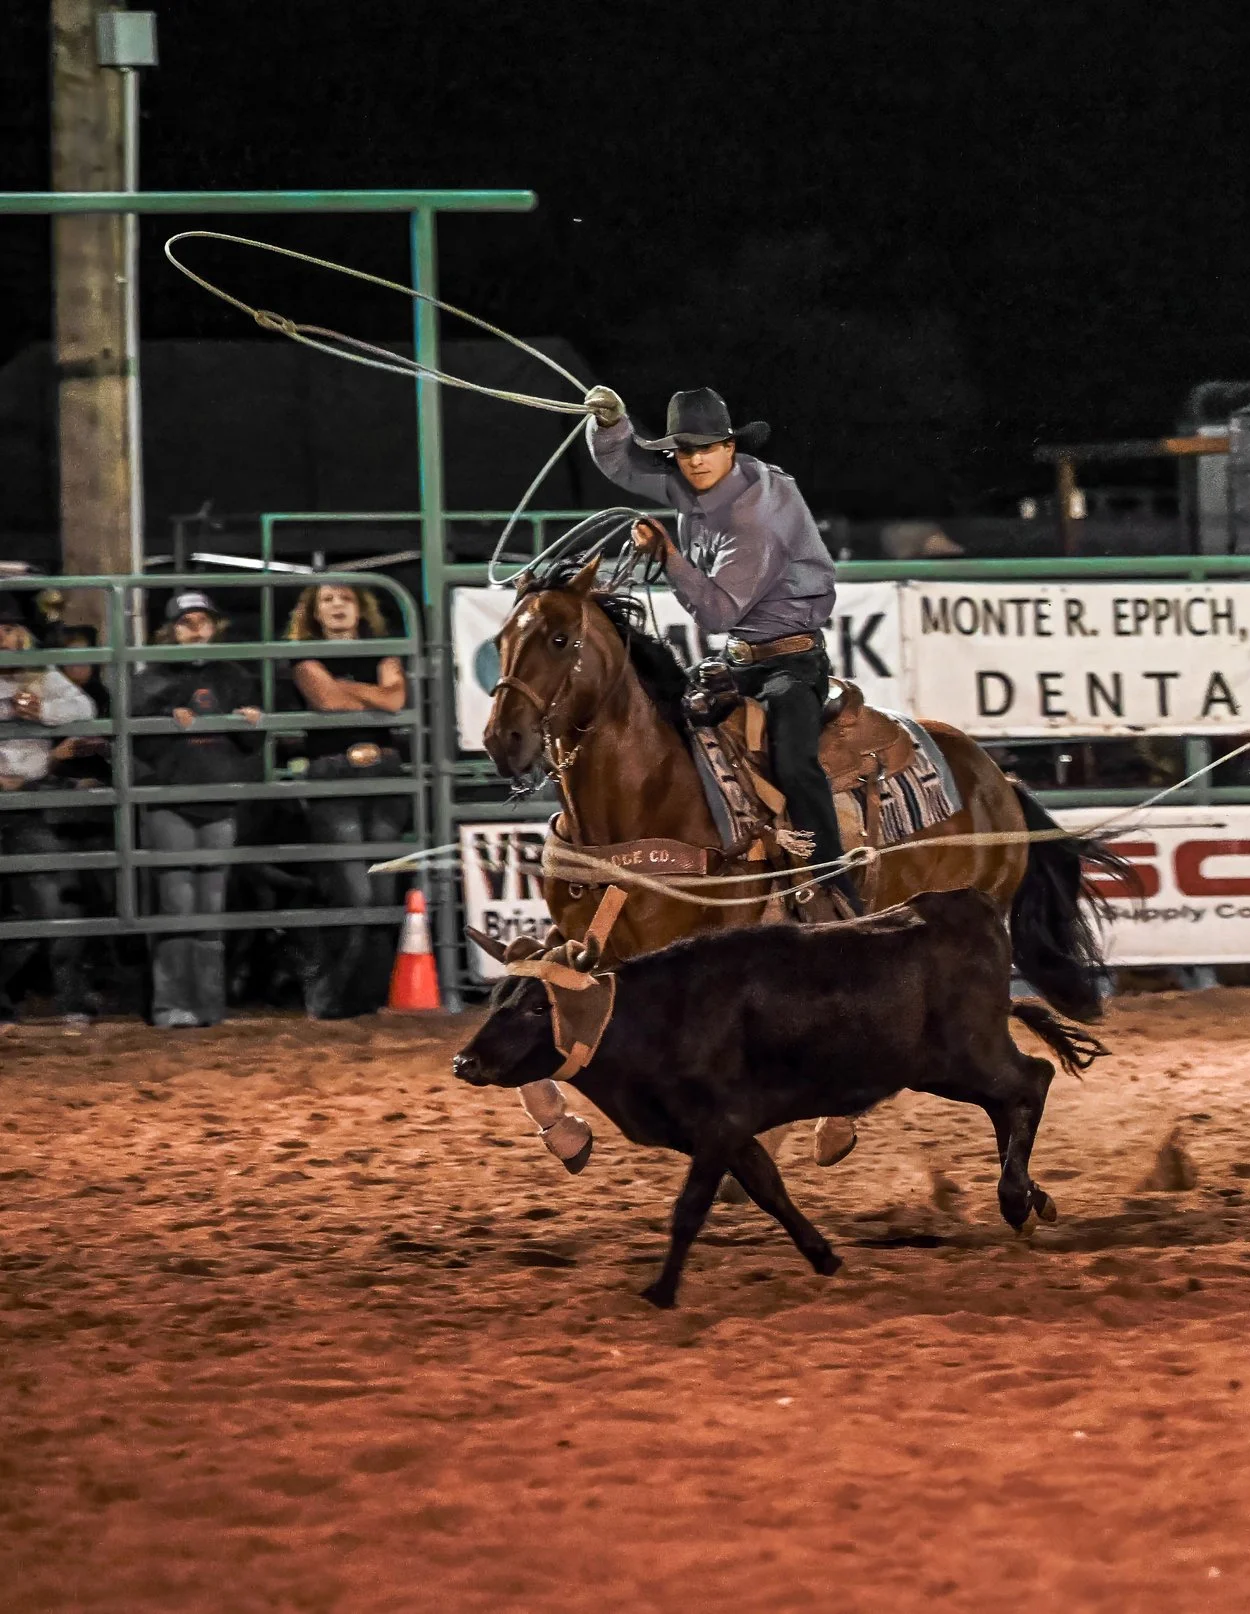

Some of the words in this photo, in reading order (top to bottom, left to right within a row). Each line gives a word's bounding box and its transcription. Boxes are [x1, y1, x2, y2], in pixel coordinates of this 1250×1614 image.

[921, 596, 1052, 637] MONTE
[1065, 597, 1099, 637] R.
[1114, 596, 1249, 643] EPPICH,
